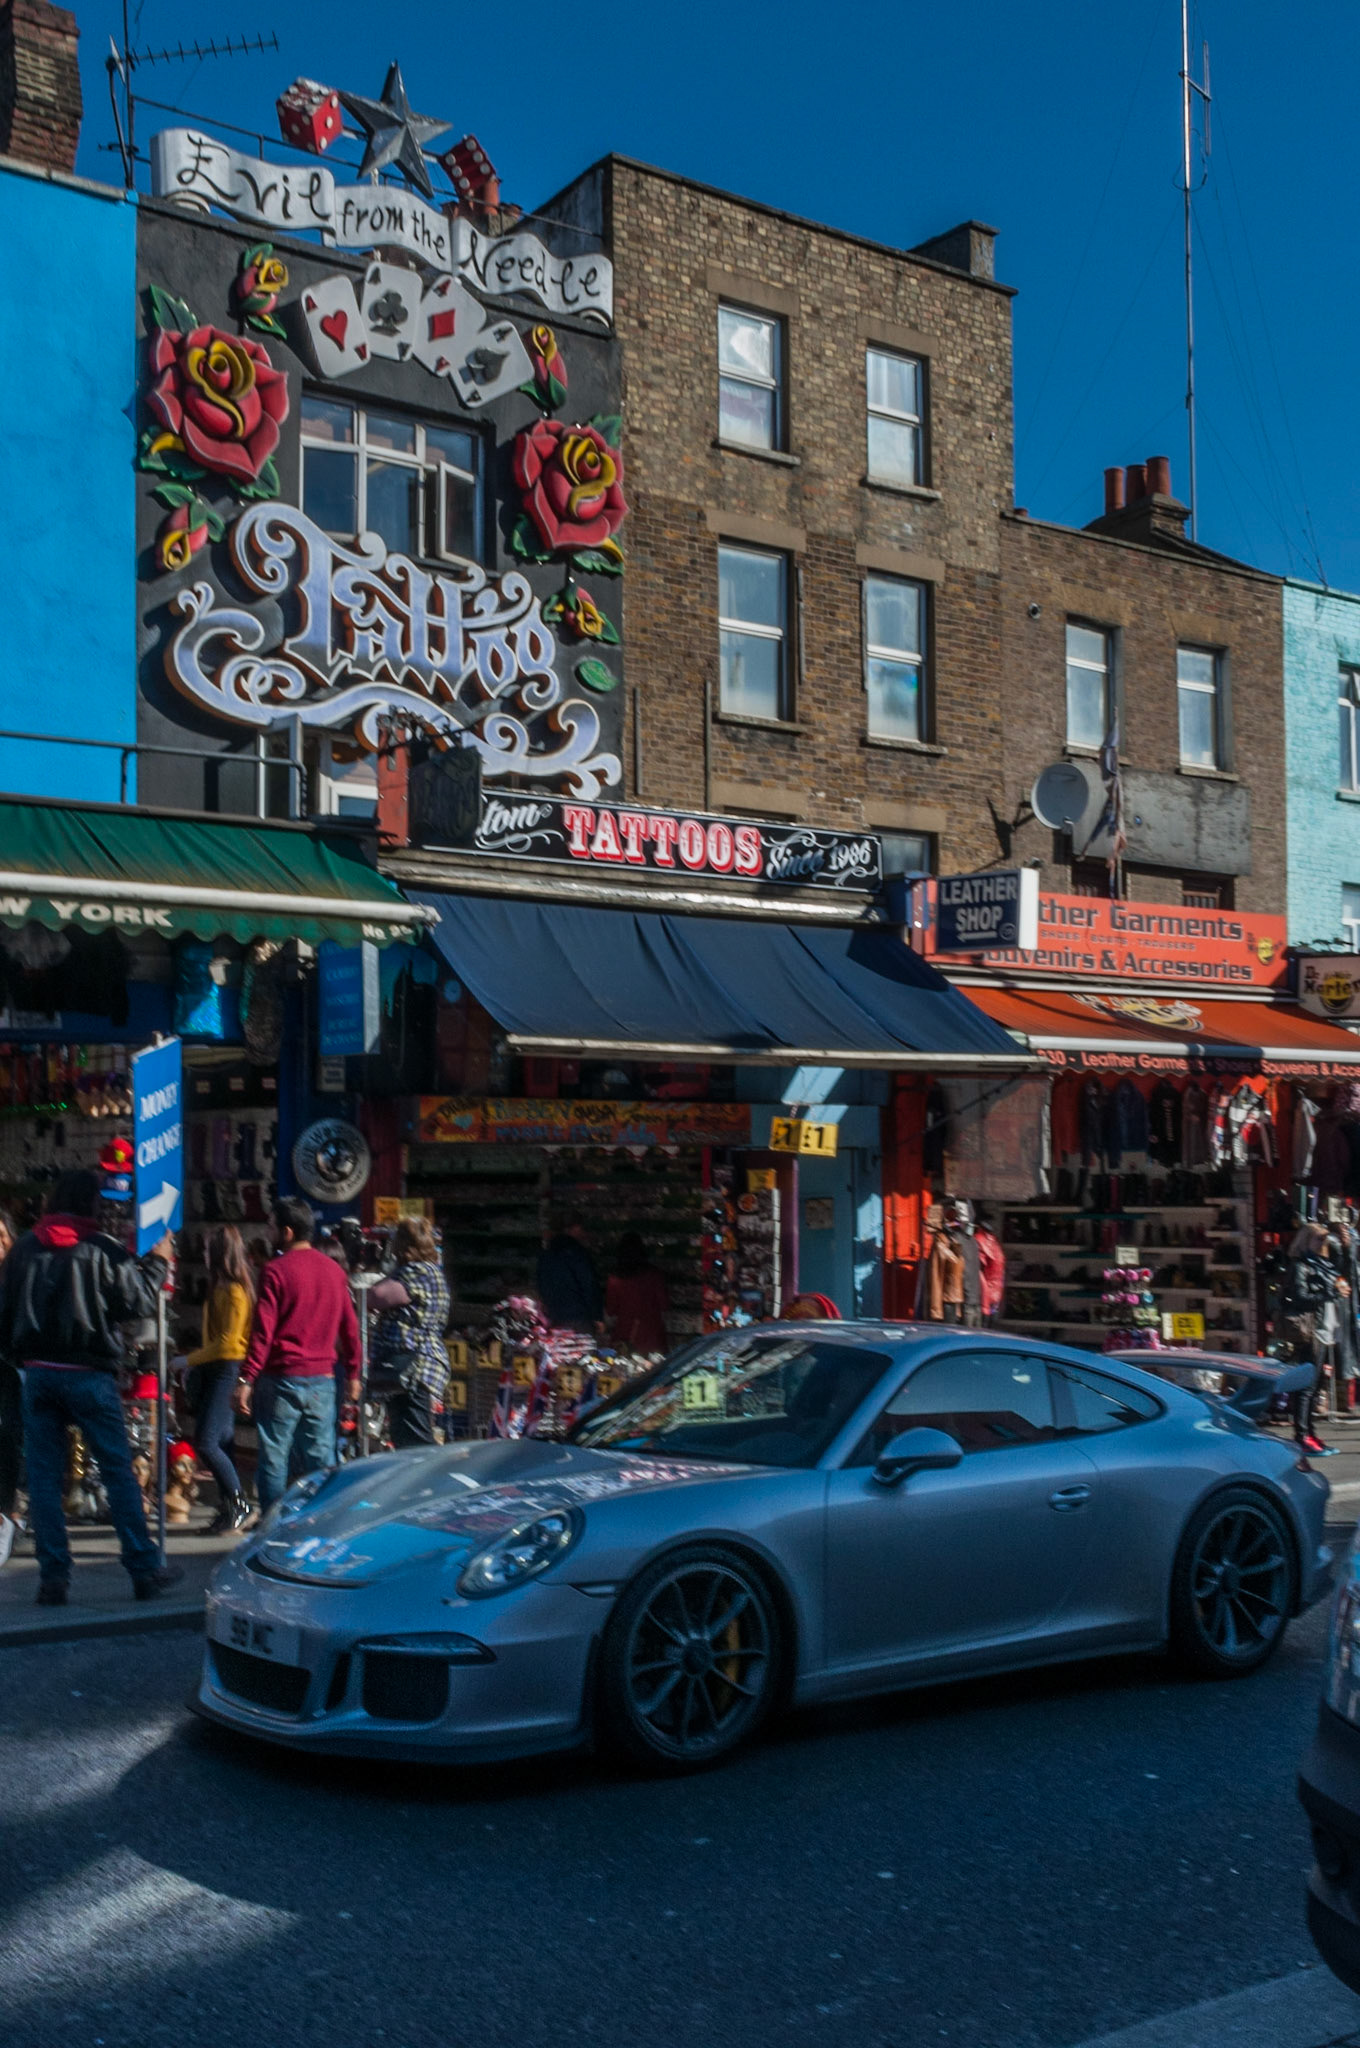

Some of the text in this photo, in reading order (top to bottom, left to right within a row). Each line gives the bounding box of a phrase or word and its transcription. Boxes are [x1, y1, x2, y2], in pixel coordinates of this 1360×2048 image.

[177, 132, 602, 304] Evil from the Needle
[475, 799, 872, 880] tom TATTOOS Since 1986
[941, 876, 1018, 906] LEATHER
[48, 898, 174, 928] YORK
[956, 906, 1004, 931] SHOP
[1038, 899, 1243, 941] ther Garments
[1041, 929, 1196, 951] SHOES BOOTS TROUSERS
[974, 946, 1253, 981] ouvenirs & Accessories
[1081, 1051, 1137, 1068] Leather
[1261, 1059, 1319, 1076] Souvenirs
